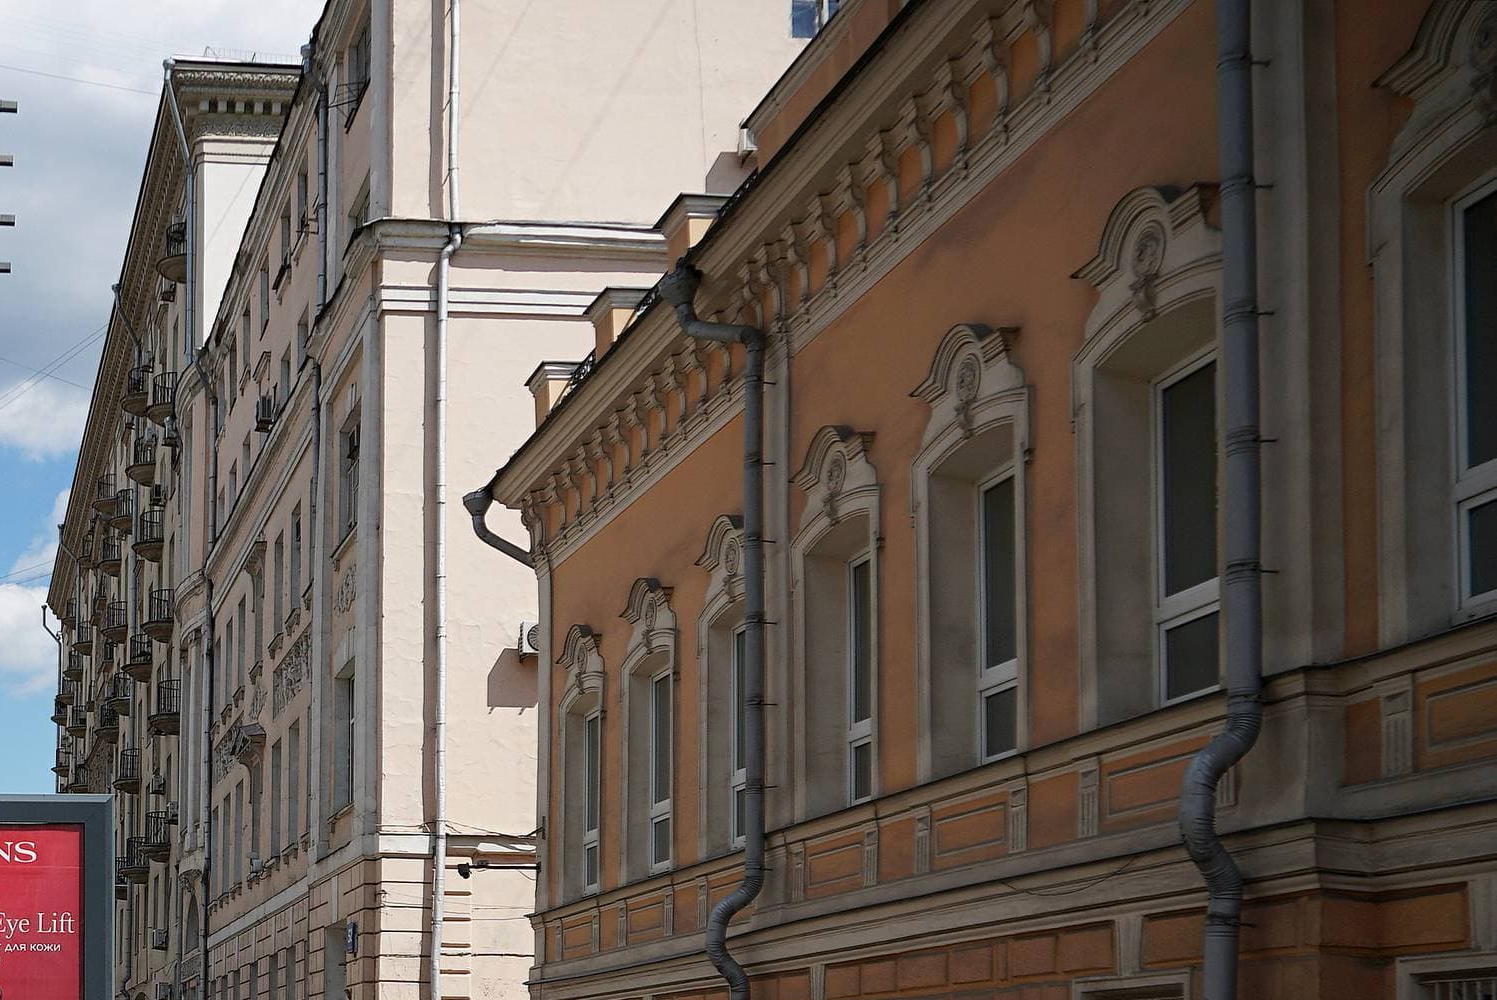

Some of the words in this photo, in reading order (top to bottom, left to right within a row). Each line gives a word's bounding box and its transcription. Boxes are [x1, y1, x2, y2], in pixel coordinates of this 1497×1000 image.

[37, 912, 75, 933] Lift
[4, 943, 27, 952] для
[30, 943, 61, 952] кожи
